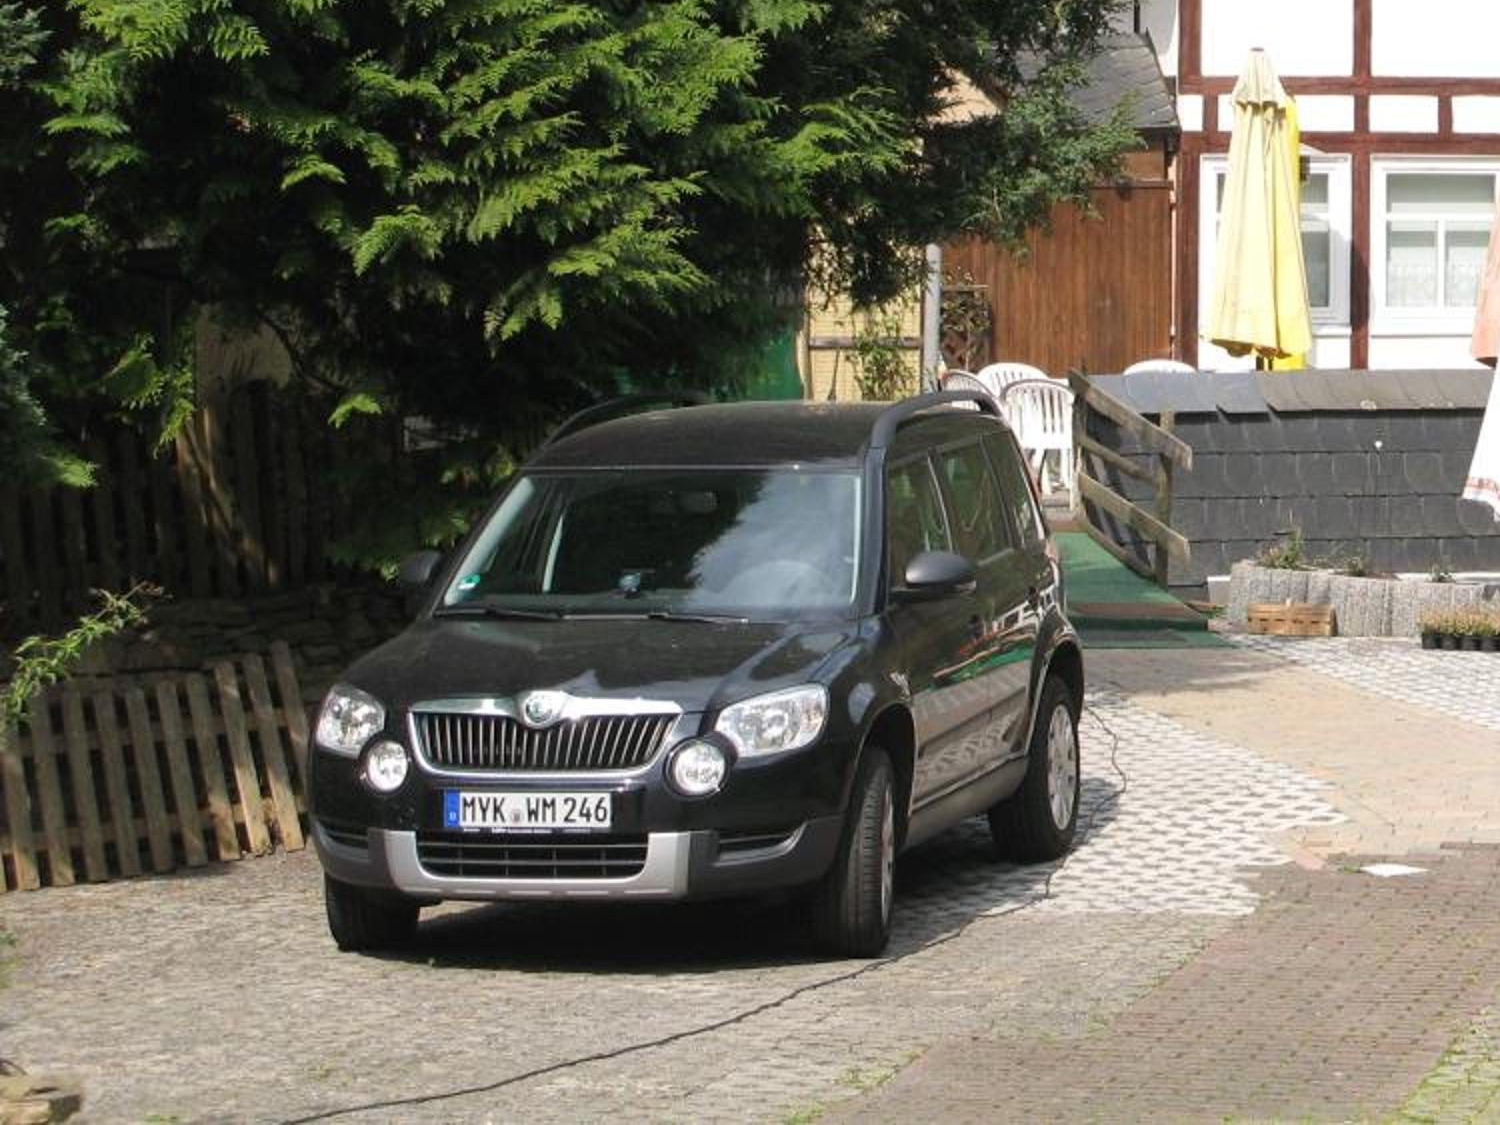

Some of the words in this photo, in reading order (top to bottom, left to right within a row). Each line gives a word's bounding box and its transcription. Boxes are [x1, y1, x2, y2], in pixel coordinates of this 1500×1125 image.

[463, 797, 505, 822] MYK
[527, 797, 556, 822] WM
[563, 797, 607, 822] 246
